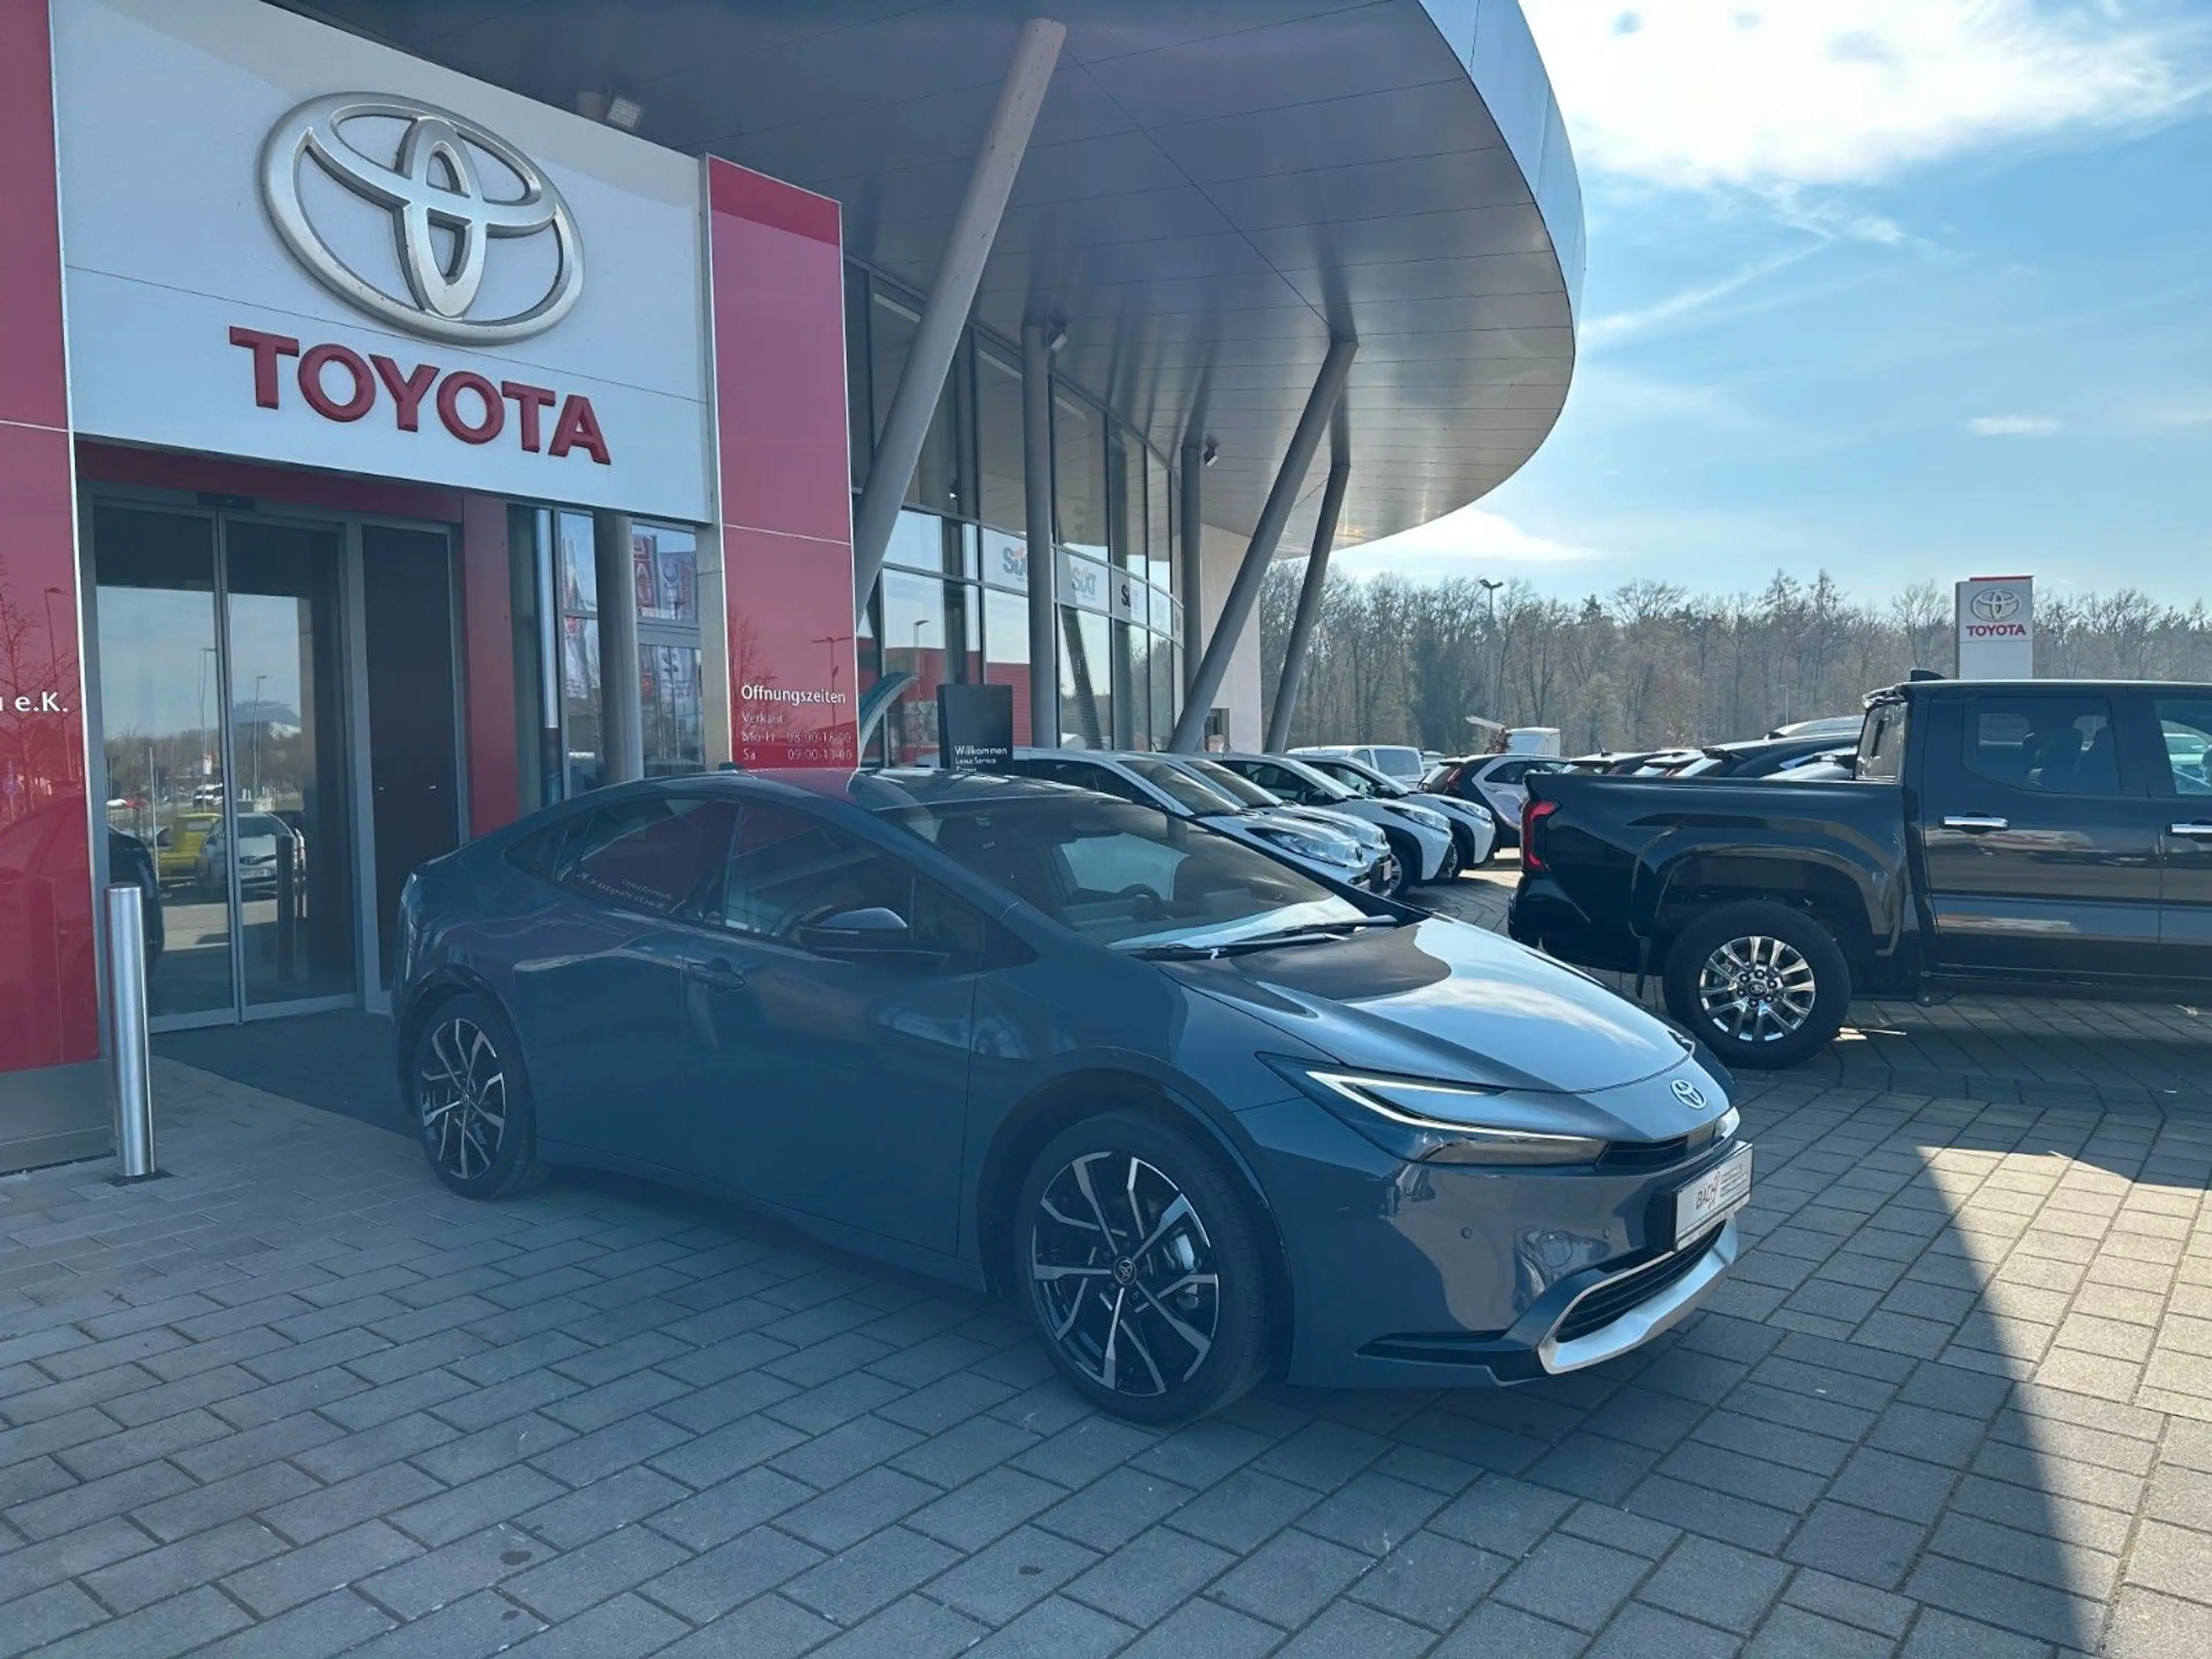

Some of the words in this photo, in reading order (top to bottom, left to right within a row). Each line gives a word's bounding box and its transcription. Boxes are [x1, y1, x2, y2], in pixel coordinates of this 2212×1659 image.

[229, 325, 611, 466] TOYOTA
[1966, 624, 2027, 637] TOYOTA
[14, 691, 69, 713] e.K.
[741, 683, 846, 706] Öffnungszeiten
[743, 748, 756, 760] Sa
[955, 745, 1007, 756] Willkommen
